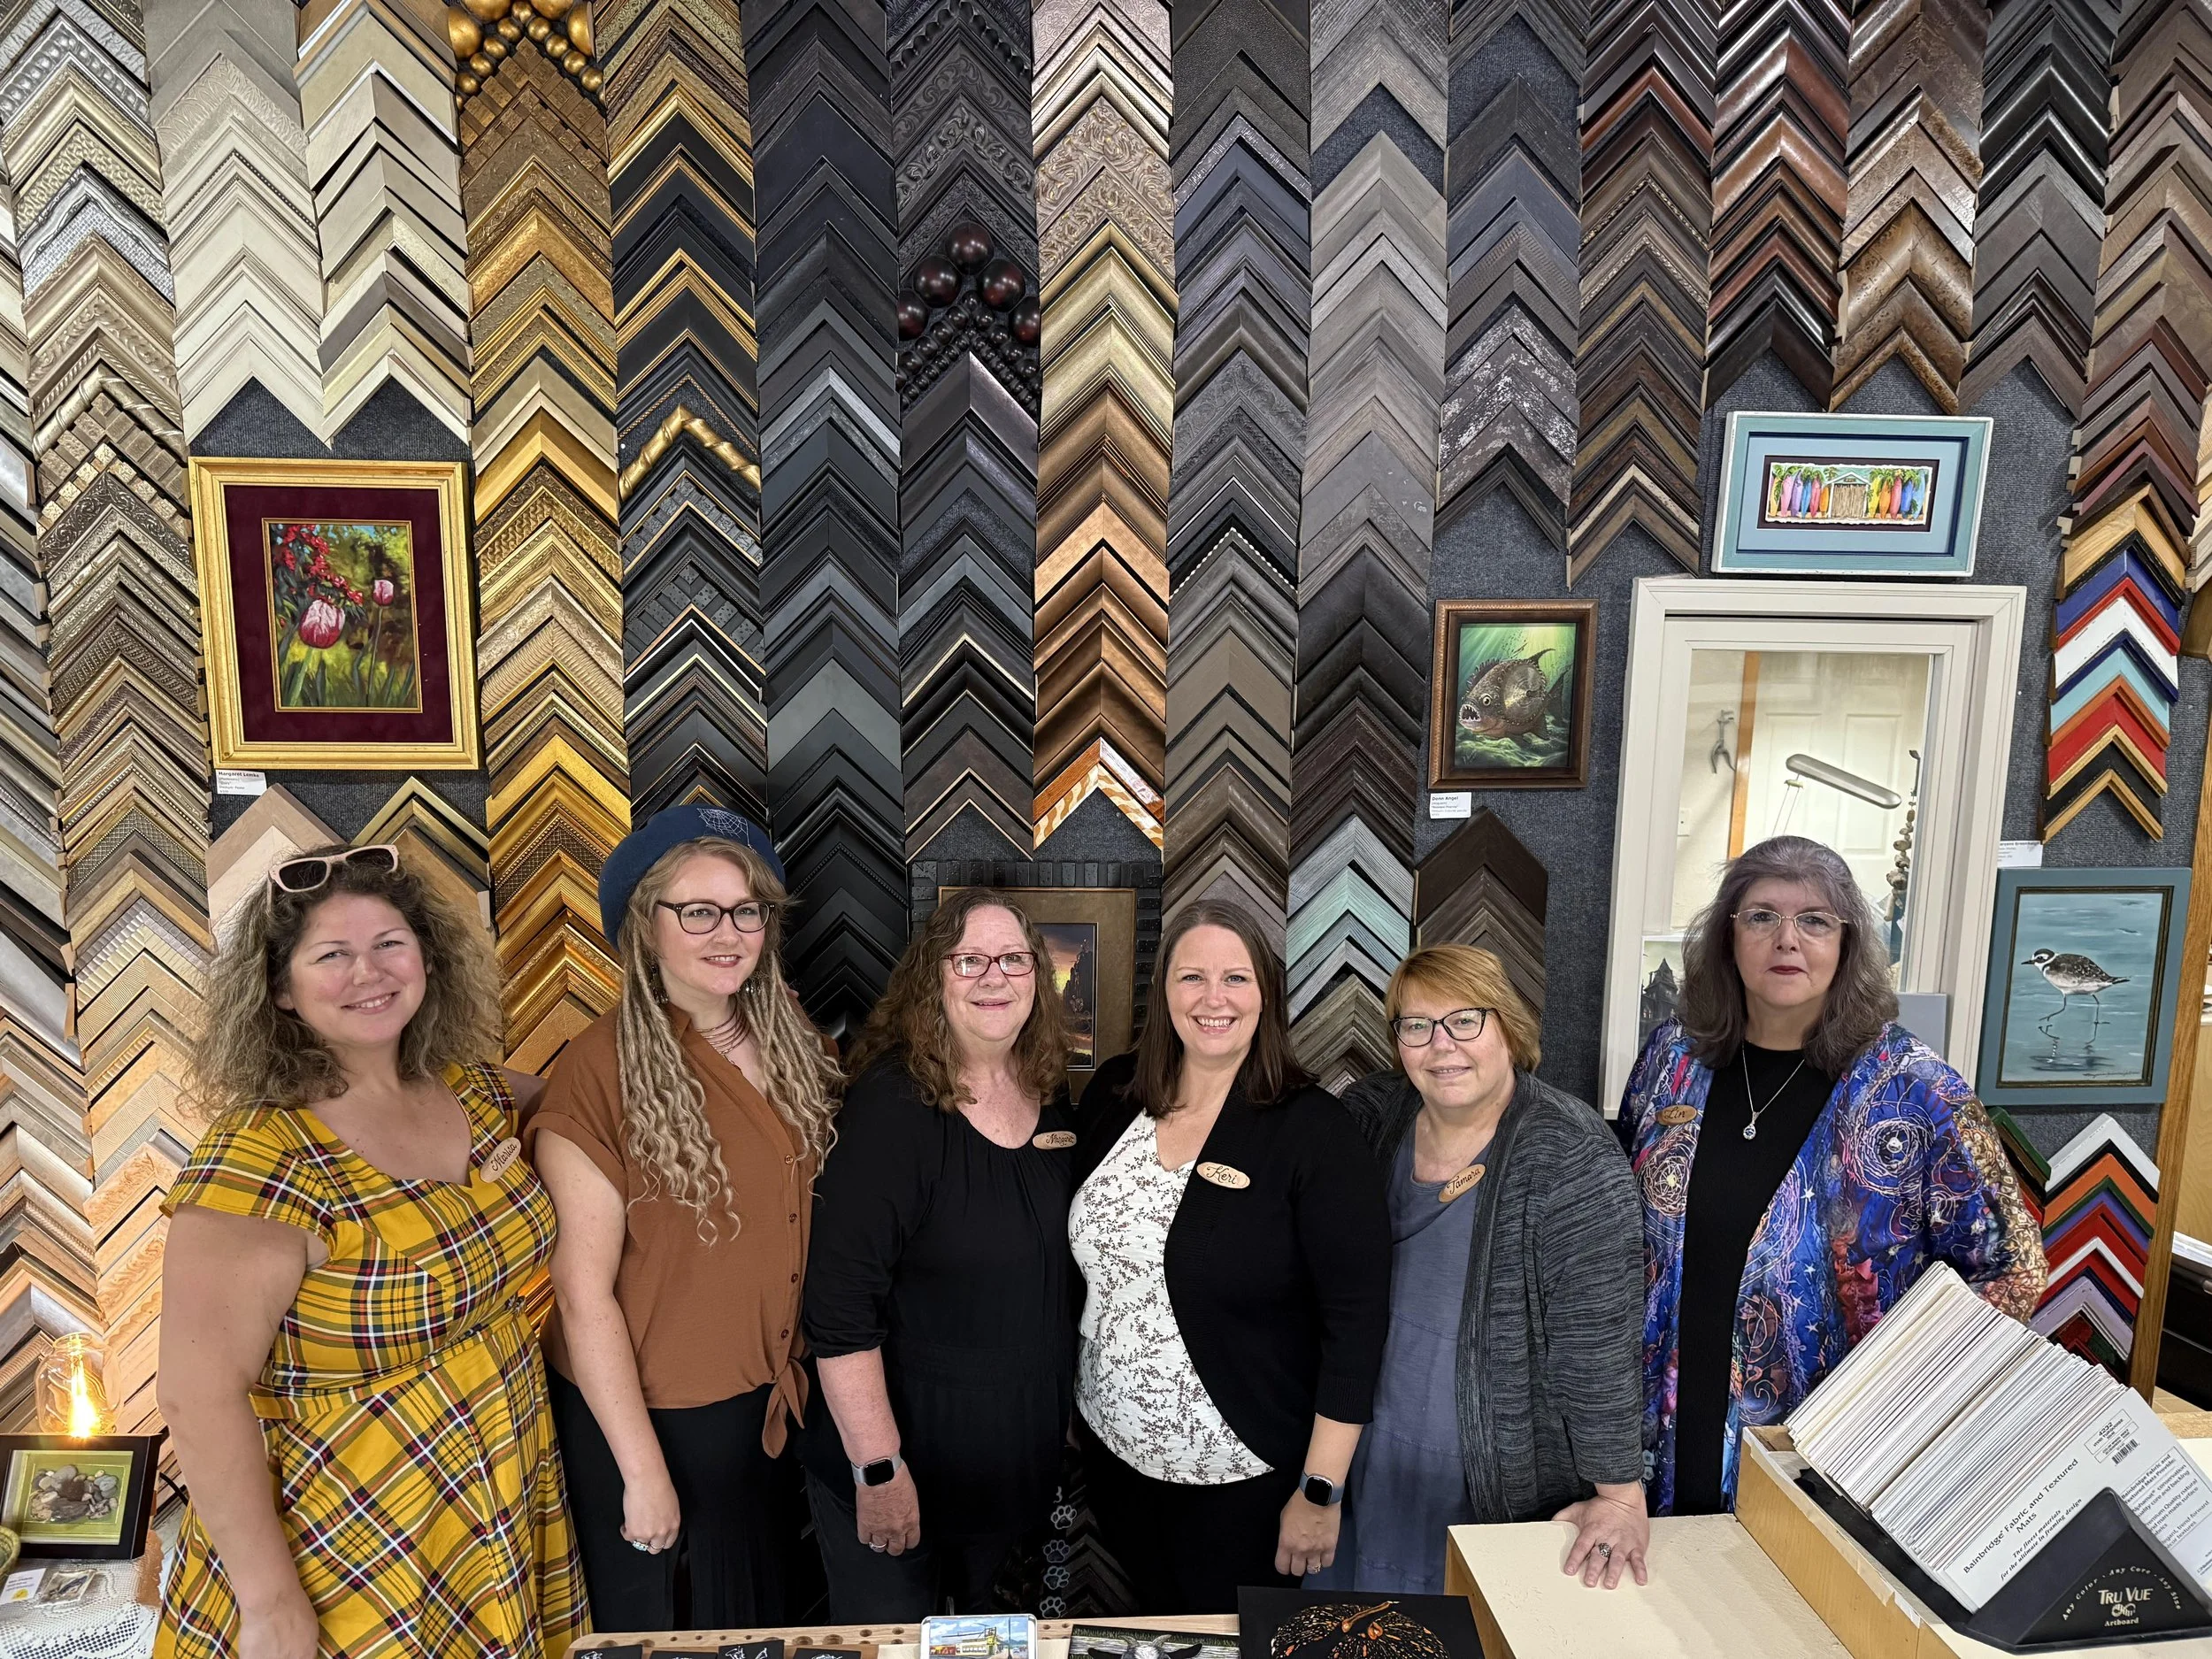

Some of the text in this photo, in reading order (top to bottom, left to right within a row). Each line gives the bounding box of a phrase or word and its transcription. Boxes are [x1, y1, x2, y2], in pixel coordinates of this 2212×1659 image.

[490, 1143, 518, 1171] Marisa
[1206, 1165, 1238, 1184] Keri
[1446, 1168, 1481, 1194] Tamara
[2121, 1454, 2171, 1500] Bainbridge Fabric and
[2144, 1475, 2157, 1487] Mats
[2156, 1464, 2187, 1492] conservation
[2003, 1507, 2029, 1532] Fabric
[2029, 1492, 2045, 1509] and
[2042, 1458, 2078, 1493] Textured
[2138, 1470, 2191, 1517] uality core and backing
[2163, 1491, 2182, 1510] Quality
[2180, 1478, 2198, 1496] natural
[2016, 1512, 2037, 1533] Mats
[2157, 1502, 2182, 1525] man-made
[2177, 1516, 2191, 1531] trend
[2190, 1500, 2209, 1518] forward
[2000, 1569, 2009, 1581] for
[2008, 1560, 2018, 1571] the
[2017, 1540, 2039, 1562] ultimate
[2044, 1515, 2066, 1539] framing
[2064, 1498, 2083, 1517] design
[2013, 1509, 2061, 1558] The finest materials
[2177, 1520, 2197, 1540] textures
[2062, 1603, 2074, 1620] Any
[2076, 1578, 2098, 1600] Color
[2130, 1565, 2151, 1574] Core
[2159, 1577, 2172, 1590] Any
[2170, 1592, 2181, 1609] Size
[2098, 1586, 2154, 1605] TRU VUE
[2105, 1617, 2139, 1626] Artboard
